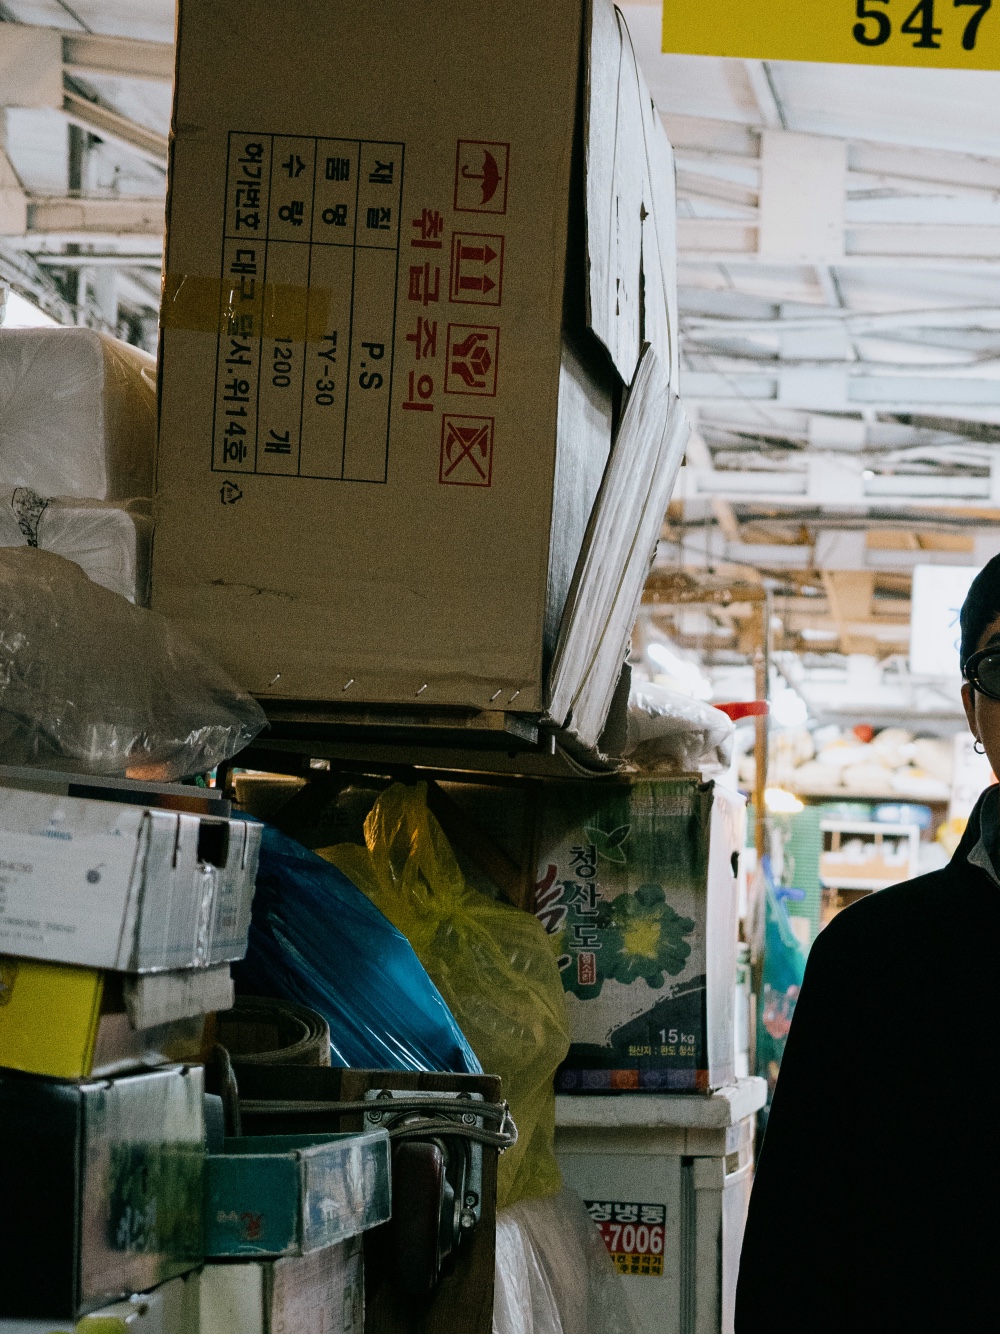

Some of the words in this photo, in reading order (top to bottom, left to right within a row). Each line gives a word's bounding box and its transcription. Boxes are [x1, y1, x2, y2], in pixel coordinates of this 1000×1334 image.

[234, 142, 264, 231] 허가번호
[402, 208, 444, 412] 취급주의
[272, 337, 294, 388] 1200
[315, 330, 338, 407] TY-30
[358, 341, 386, 390] P.S
[264, 429, 291, 454] 개
[569, 844, 603, 949] 청산도
[588, 1203, 664, 1224] 성냉동
[595, 1223, 664, 1254] -7006
